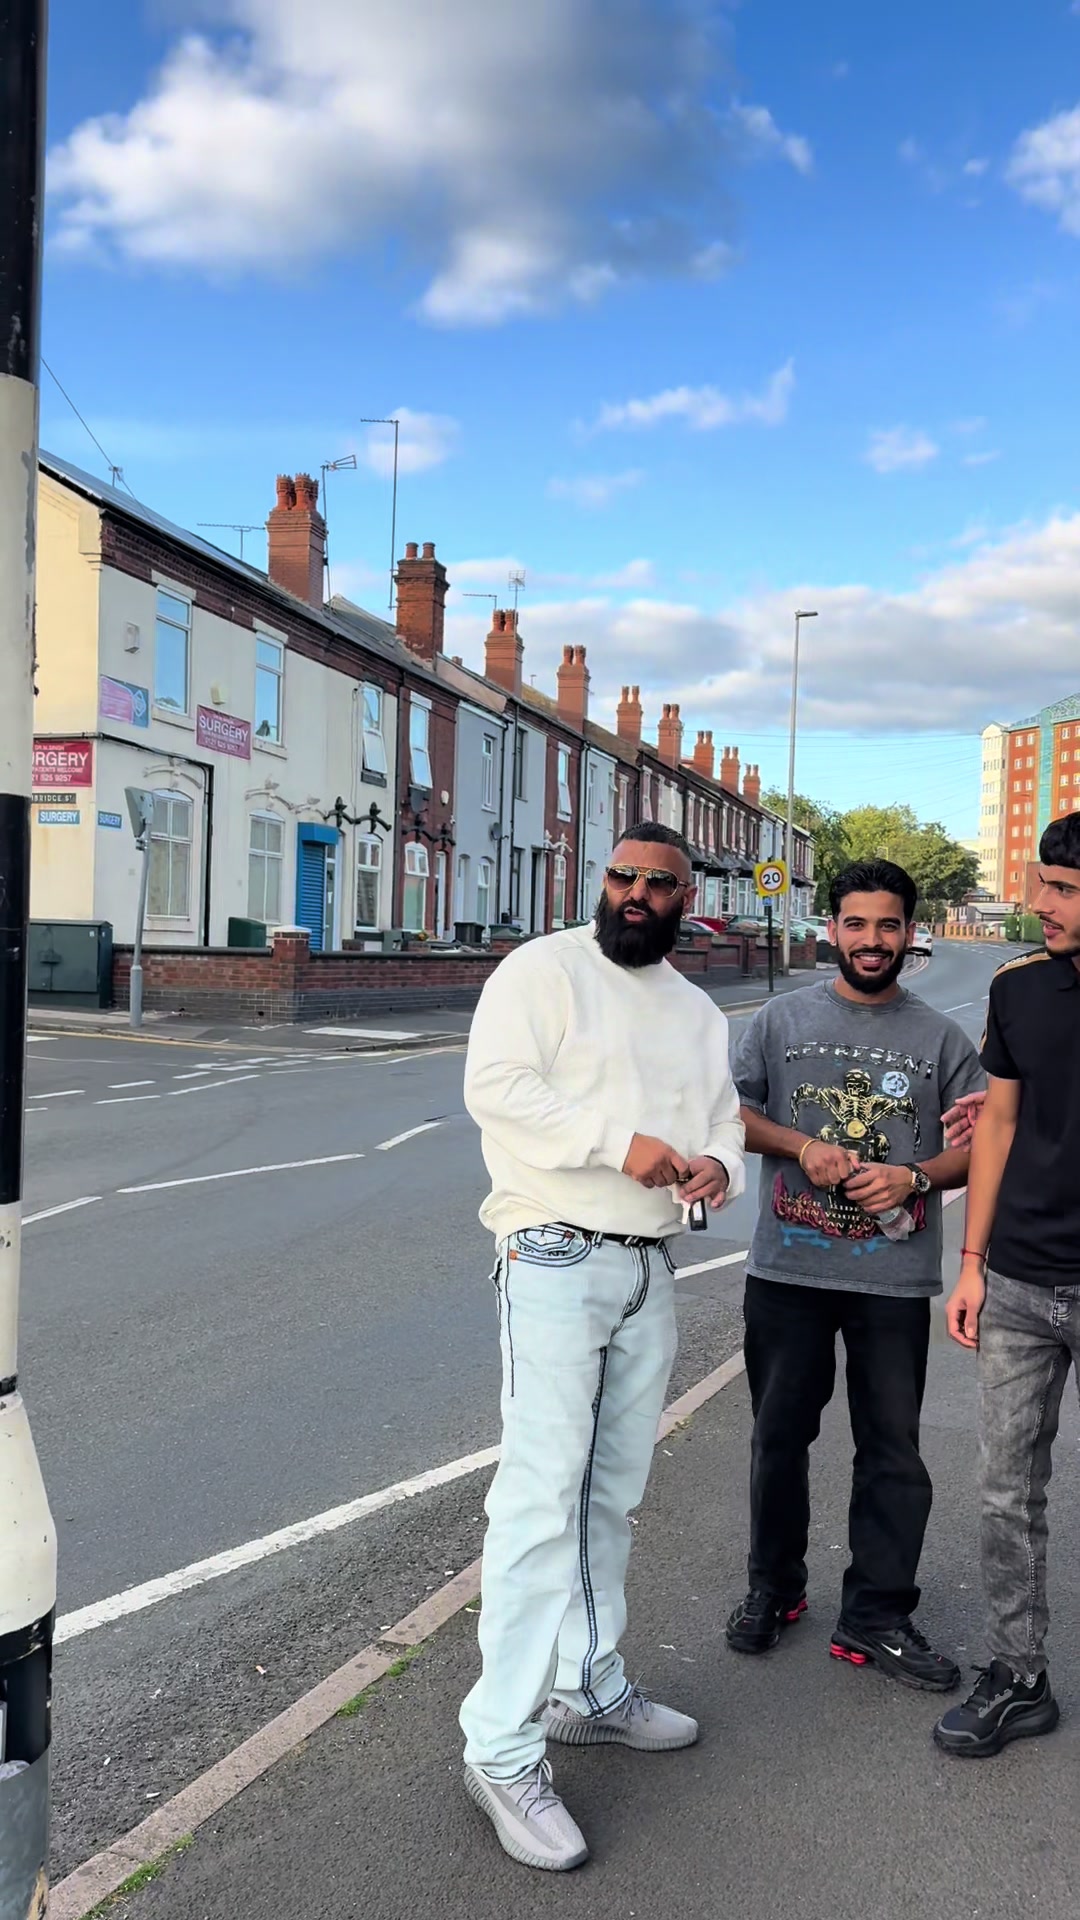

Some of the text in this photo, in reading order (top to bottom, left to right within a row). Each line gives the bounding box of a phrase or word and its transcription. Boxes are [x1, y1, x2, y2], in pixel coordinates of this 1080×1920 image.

[199, 715, 248, 742] SURGERY
[31, 794, 62, 802] BRIDGE
[40, 811, 77, 822] SURGERY
[99, 813, 121, 826] SURGERY
[763, 872, 780, 885] 20
[785, 1041, 938, 1080] REPRESENT
